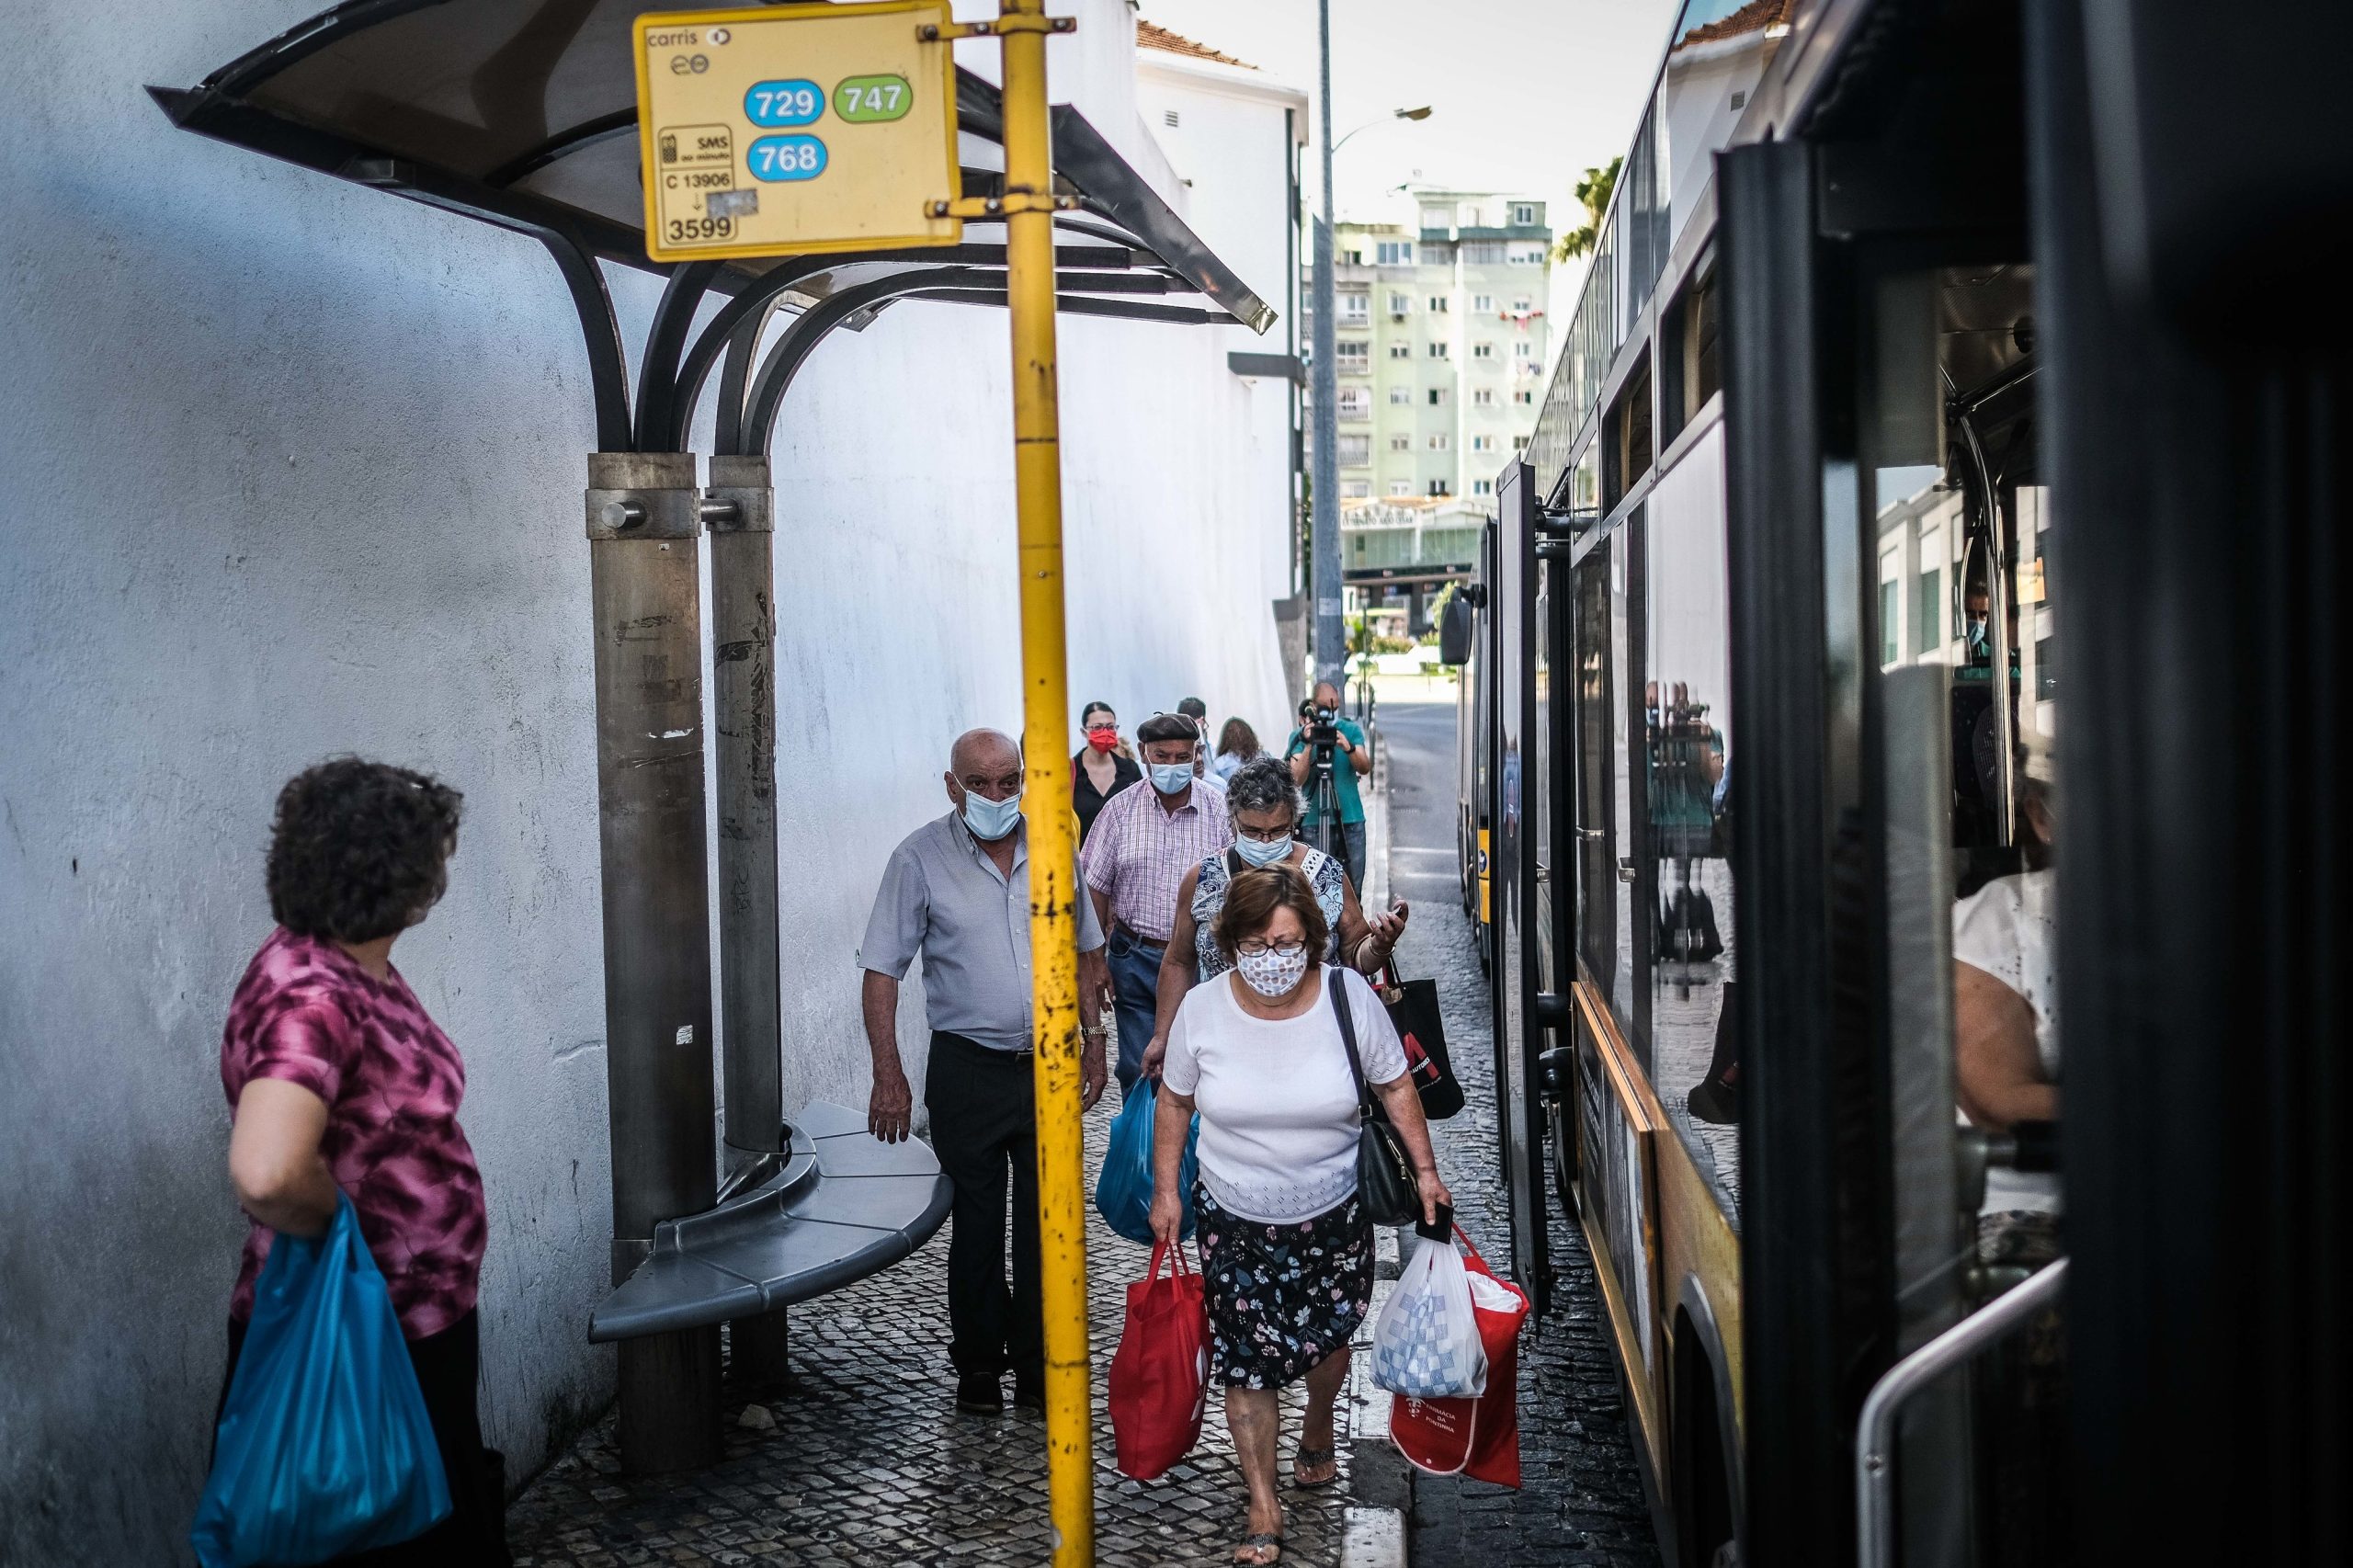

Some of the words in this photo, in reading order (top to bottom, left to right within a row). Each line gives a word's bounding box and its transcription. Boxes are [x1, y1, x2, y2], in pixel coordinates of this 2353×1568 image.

[647, 28, 698, 47] carris
[755, 89, 815, 119] 729
[844, 85, 902, 114] 747
[697, 136, 729, 150] SMS
[758, 143, 818, 173] 768
[665, 175, 678, 189] C
[684, 173, 731, 188] 13906
[669, 216, 732, 241] 3599
[1426, 1415, 1455, 1433] PONTINHA
